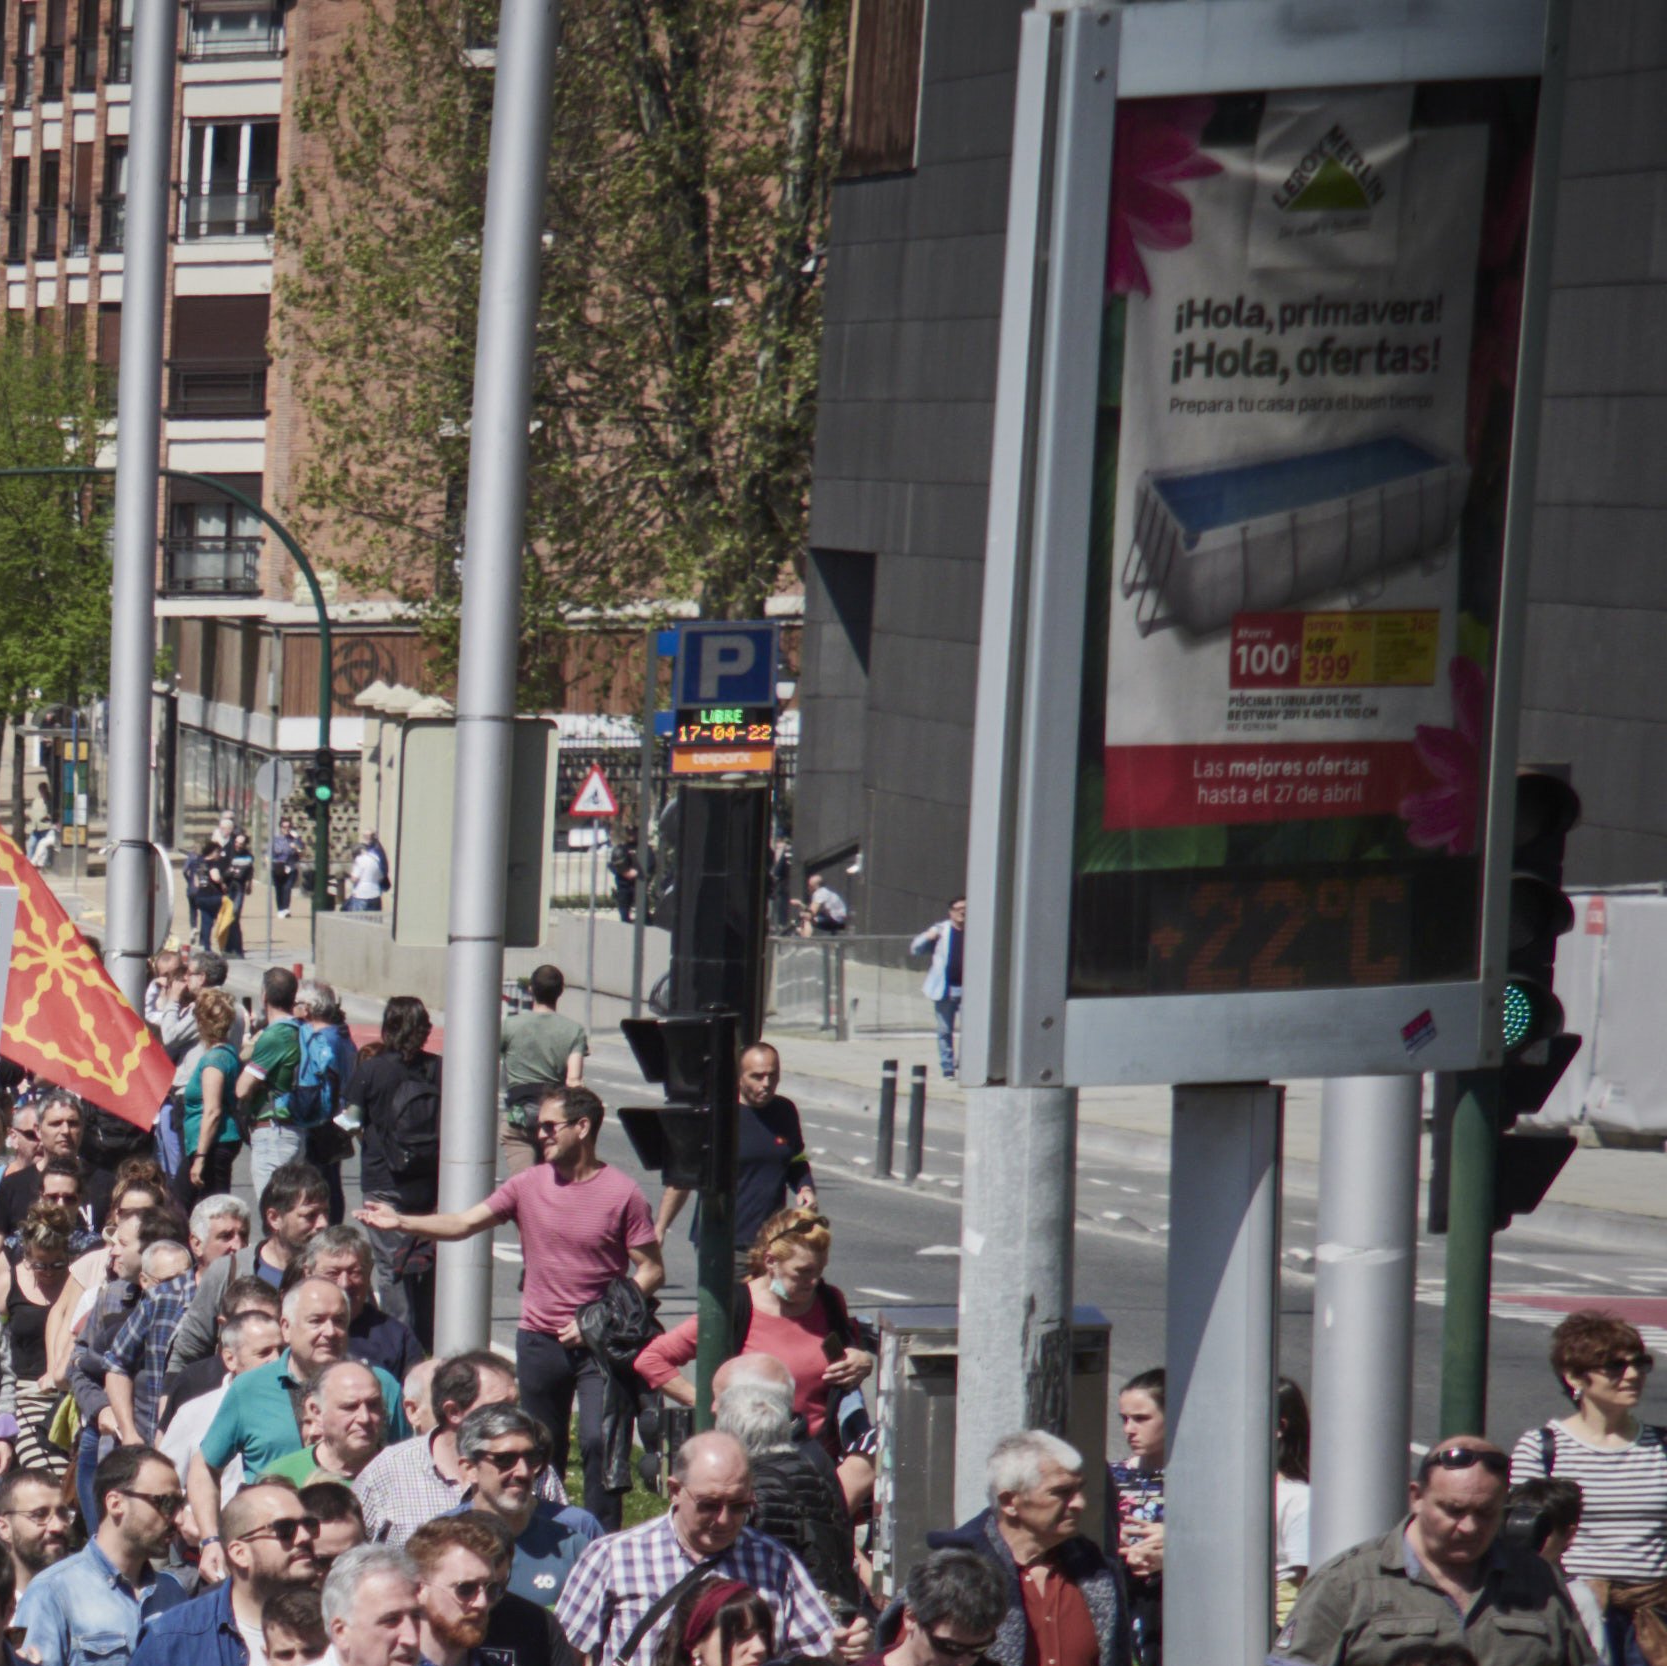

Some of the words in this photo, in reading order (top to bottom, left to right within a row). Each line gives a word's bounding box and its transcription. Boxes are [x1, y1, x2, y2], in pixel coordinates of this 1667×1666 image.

[1272, 140, 1330, 210] LEROY
[1322, 122, 1386, 205] MERLIN
[1175, 297, 1275, 335] ¡Hola,
[1278, 293, 1443, 334] primavera!
[1171, 339, 1290, 386] ¡Hola,
[1296, 336, 1442, 378] ofertas!
[1169, 397, 1234, 414] Prepara
[1237, 396, 1254, 412] tu
[1257, 398, 1294, 412] casa
[1298, 397, 1333, 415] para
[1335, 394, 1349, 410] el
[1351, 394, 1386, 410] buen
[699, 634, 755, 700] P
[701, 708, 744, 724] LIBRE
[678, 725, 773, 743] 17-04-22
[1193, 758, 1224, 778] Las
[1228, 757, 1301, 779] mejores
[1306, 755, 1369, 776] ofertas
[1197, 785, 1246, 804] hasta
[1252, 783, 1269, 803] el
[1274, 783, 1295, 802] 27
[1297, 783, 1319, 802] de
[1322, 781, 1363, 802] abril
